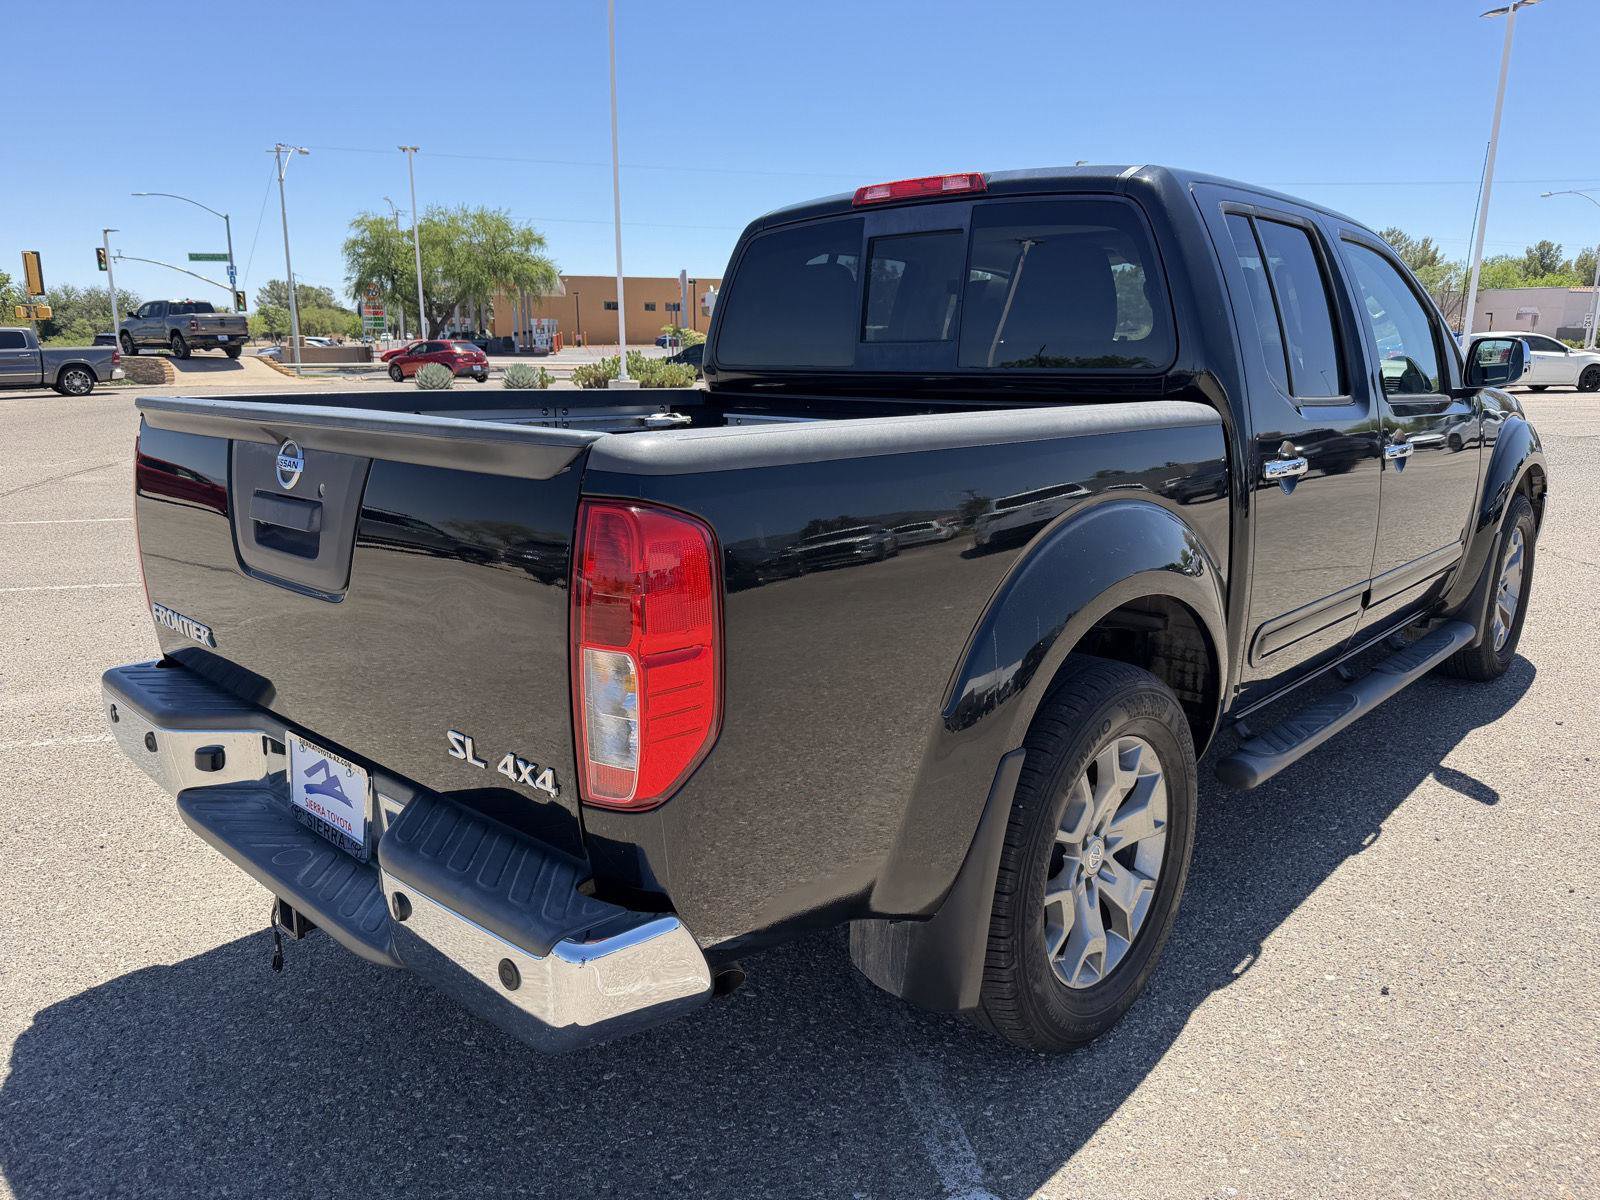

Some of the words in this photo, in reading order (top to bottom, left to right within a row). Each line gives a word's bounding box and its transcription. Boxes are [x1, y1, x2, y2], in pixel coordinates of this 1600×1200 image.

[153, 603, 214, 648] FRONTIER
[446, 730, 487, 769] SL
[497, 752, 560, 798] 4X4
[304, 797, 326, 816] SIERRA
[327, 809, 353, 834] TOYOTA
[306, 814, 346, 850] SIERRA
